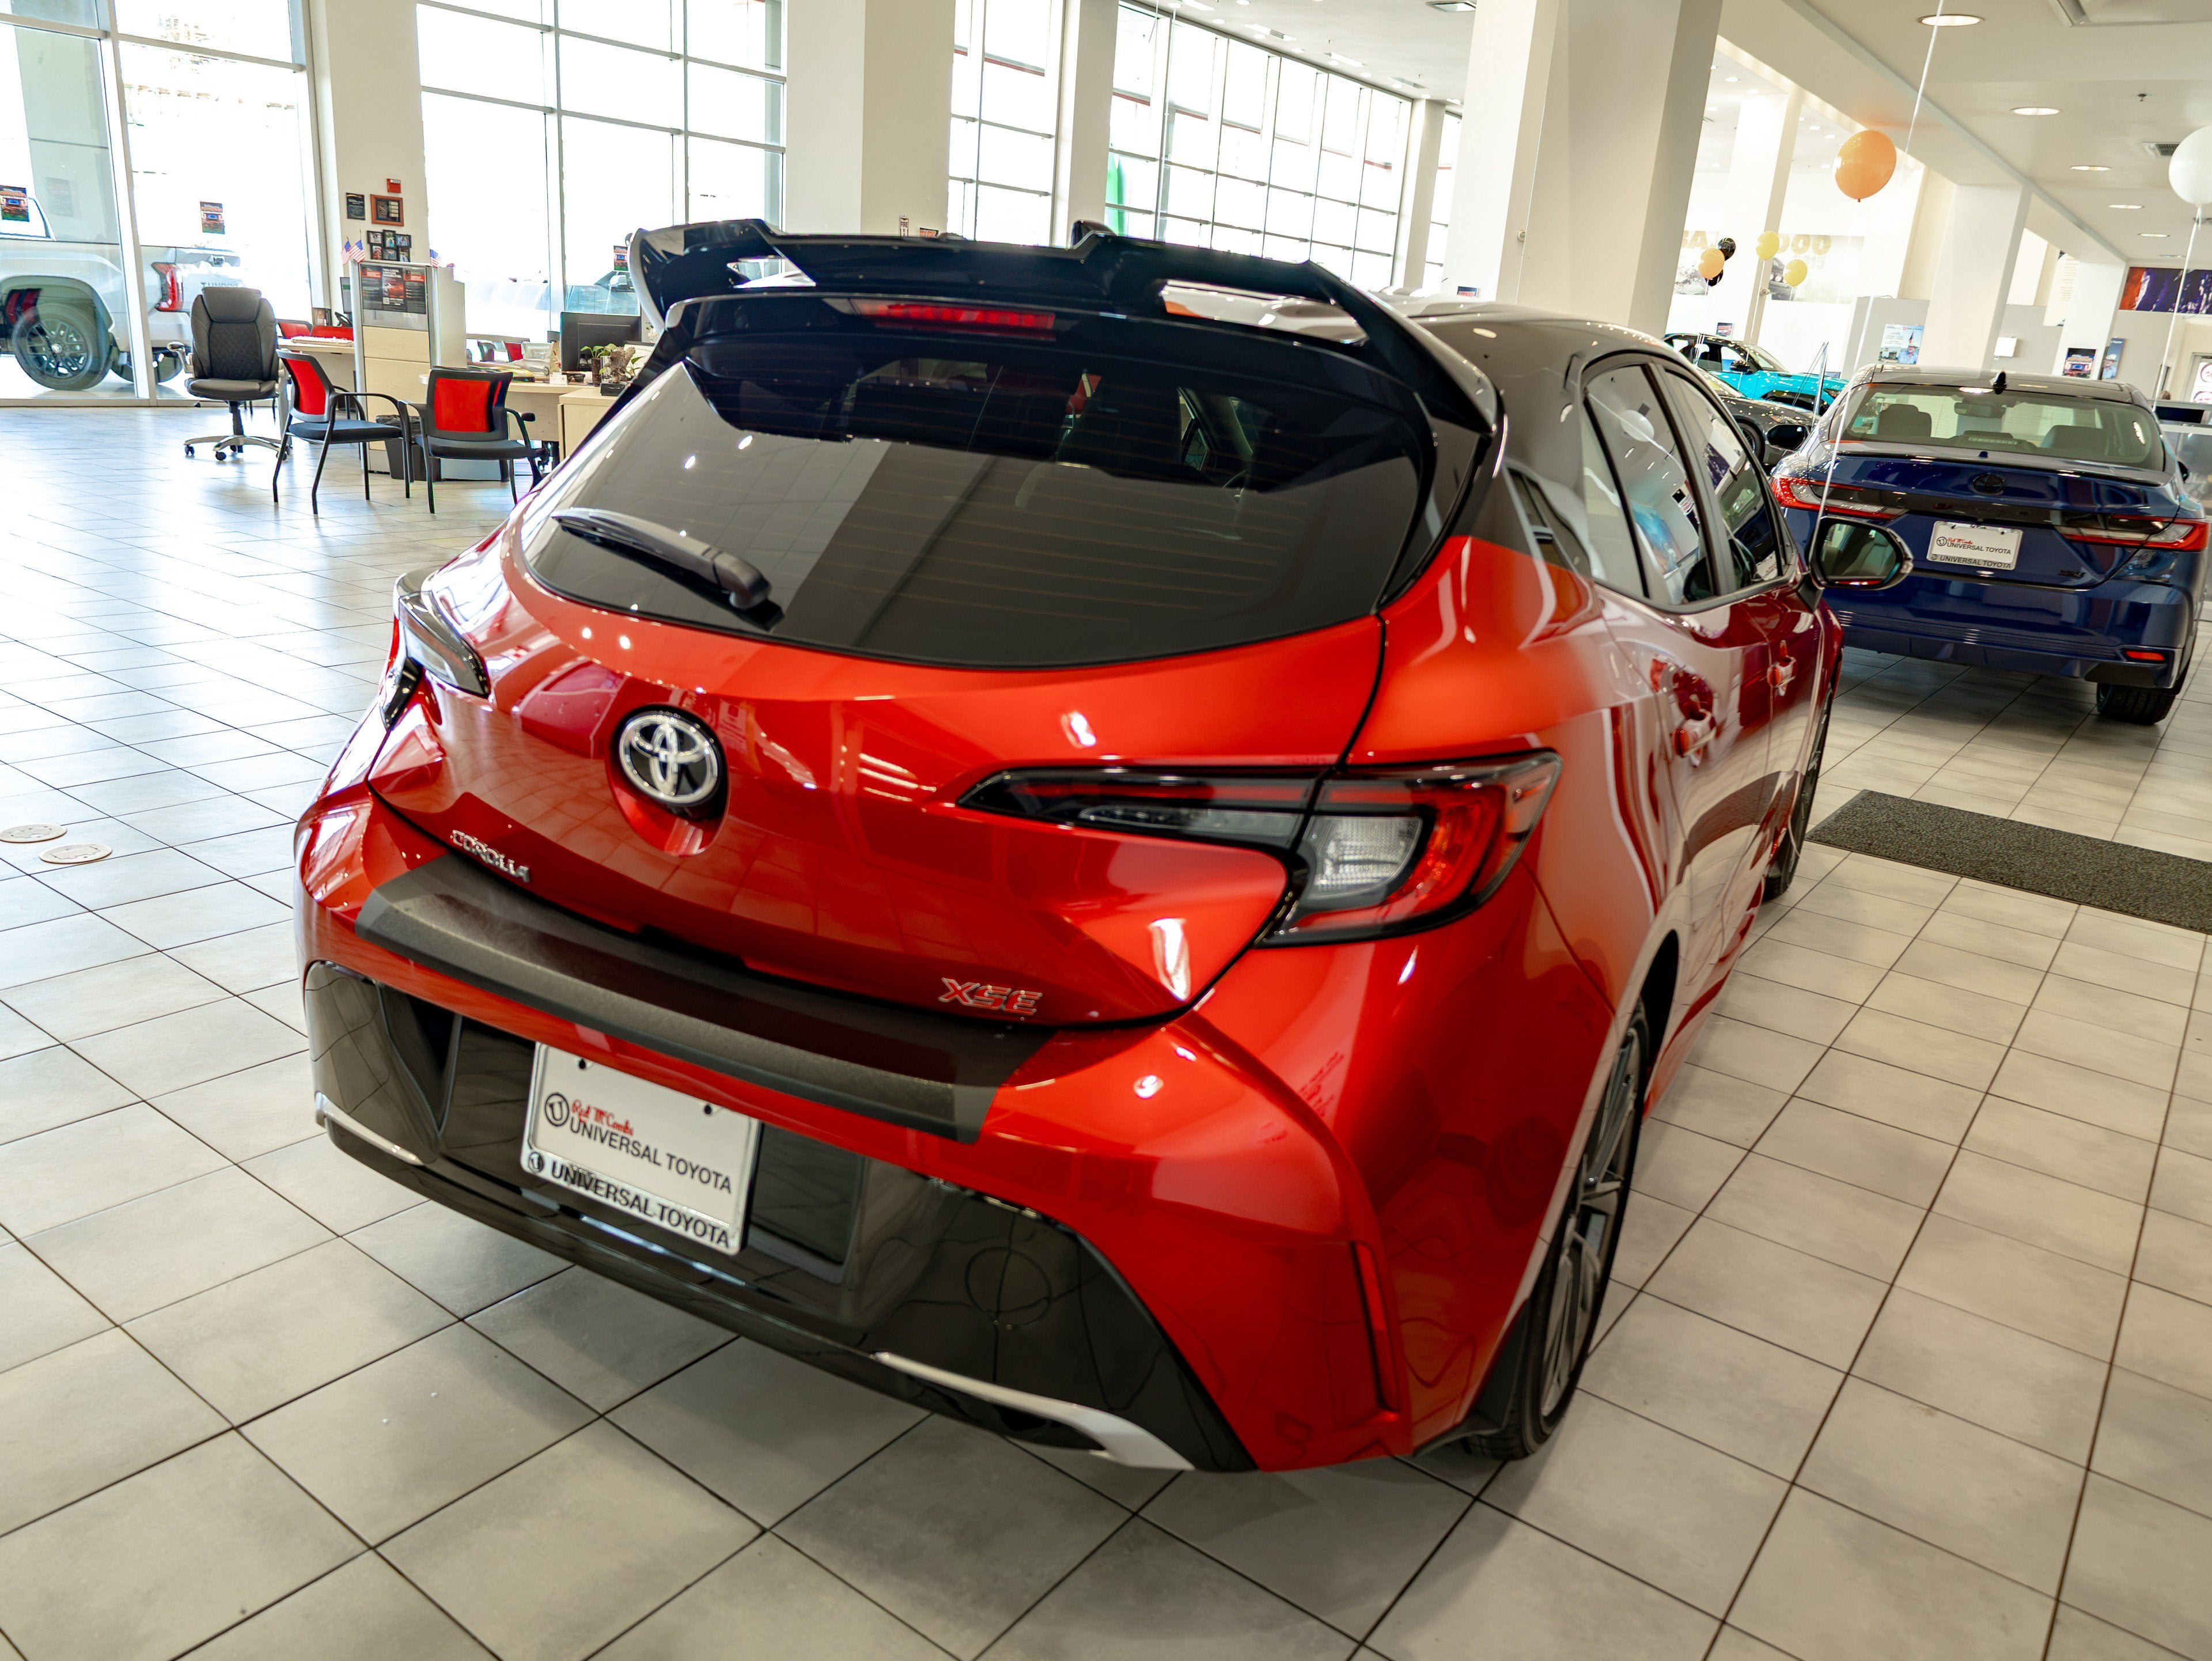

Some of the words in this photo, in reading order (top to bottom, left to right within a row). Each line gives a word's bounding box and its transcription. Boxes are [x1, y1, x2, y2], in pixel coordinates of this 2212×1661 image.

[1940, 555, 1982, 565] UNIVERSAL
[1983, 560, 2011, 569] TOYOTA
[1947, 542, 1984, 551] UNIVERSAL
[452, 830, 531, 883] COROLLA
[938, 977, 1043, 1016] XSE
[570, 1117, 662, 1166] UNIVERSAL
[666, 1152, 732, 1194] TOYOTA
[551, 1160, 655, 1217] UNIVERSAL
[658, 1203, 729, 1248] TOYOTA
